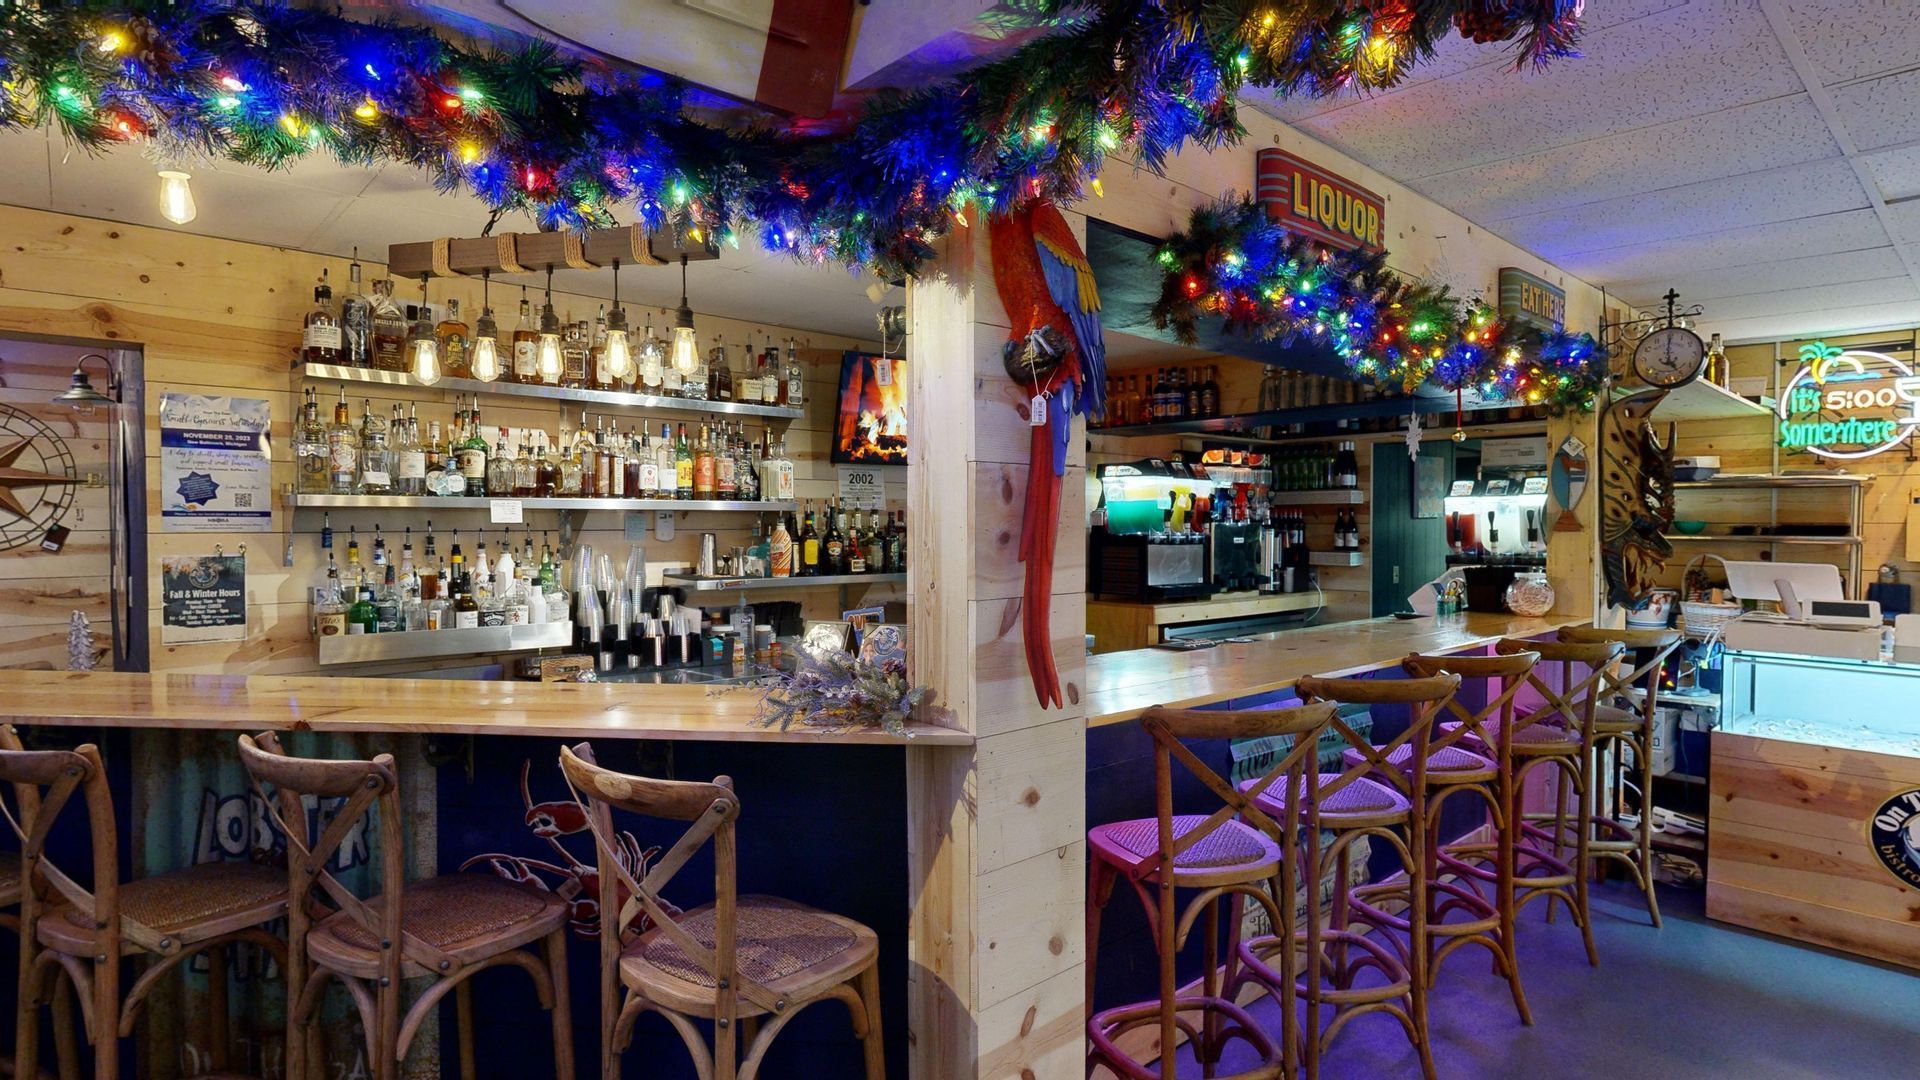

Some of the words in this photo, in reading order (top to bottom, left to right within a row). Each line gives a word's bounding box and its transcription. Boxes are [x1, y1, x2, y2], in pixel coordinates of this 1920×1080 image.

[1291, 171, 1379, 247] LIQUOR
[1521, 281, 1541, 315] EAT
[1542, 289, 1564, 324] HERE
[1790, 387, 1822, 413] It's
[1825, 387, 1897, 411] 5:00
[183, 432, 223, 440] NOVEMBER
[235, 434, 251, 442] 2023
[1779, 416, 1899, 448] Somewhere
[848, 473, 874, 485] 2002
[169, 590, 184, 599] Fall
[184, 590, 191, 599] &
[191, 589, 217, 598] Winter
[218, 588, 241, 597] Hours
[320, 616, 340, 625] Tito's
[1874, 805, 1910, 832] On
[1880, 844, 1920, 883] bistro
